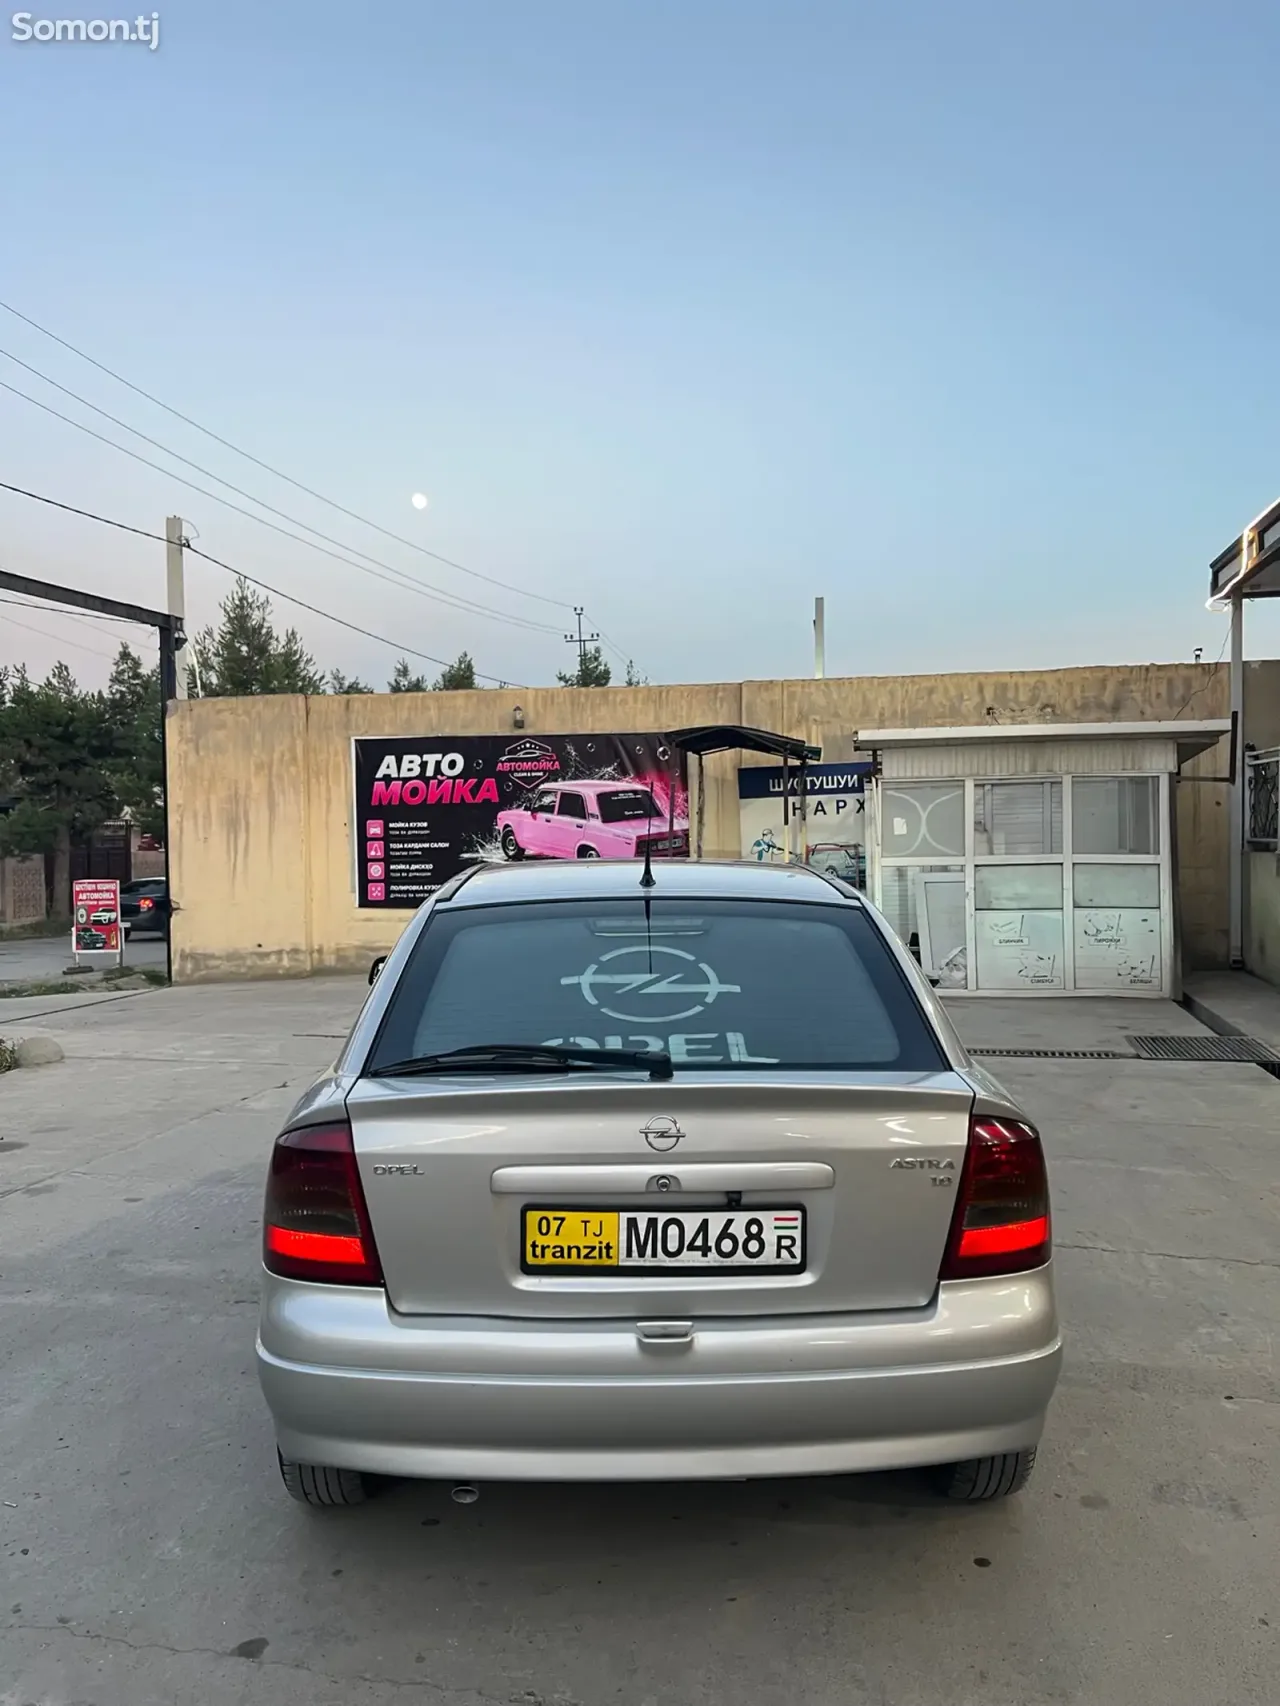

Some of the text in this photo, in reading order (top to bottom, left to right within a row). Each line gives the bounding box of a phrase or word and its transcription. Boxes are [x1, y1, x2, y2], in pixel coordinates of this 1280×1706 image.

[375, 753, 465, 778] АВТО
[496, 759, 560, 772] АВТОМОЙКА
[371, 775, 499, 806] МОЙКА
[373, 1164, 425, 1176] OPEL
[889, 1157, 955, 1170] ASTRA
[537, 1216, 604, 1238] 07 TJ
[530, 1239, 613, 1260] tranzit
[776, 1234, 797, 1260] R
